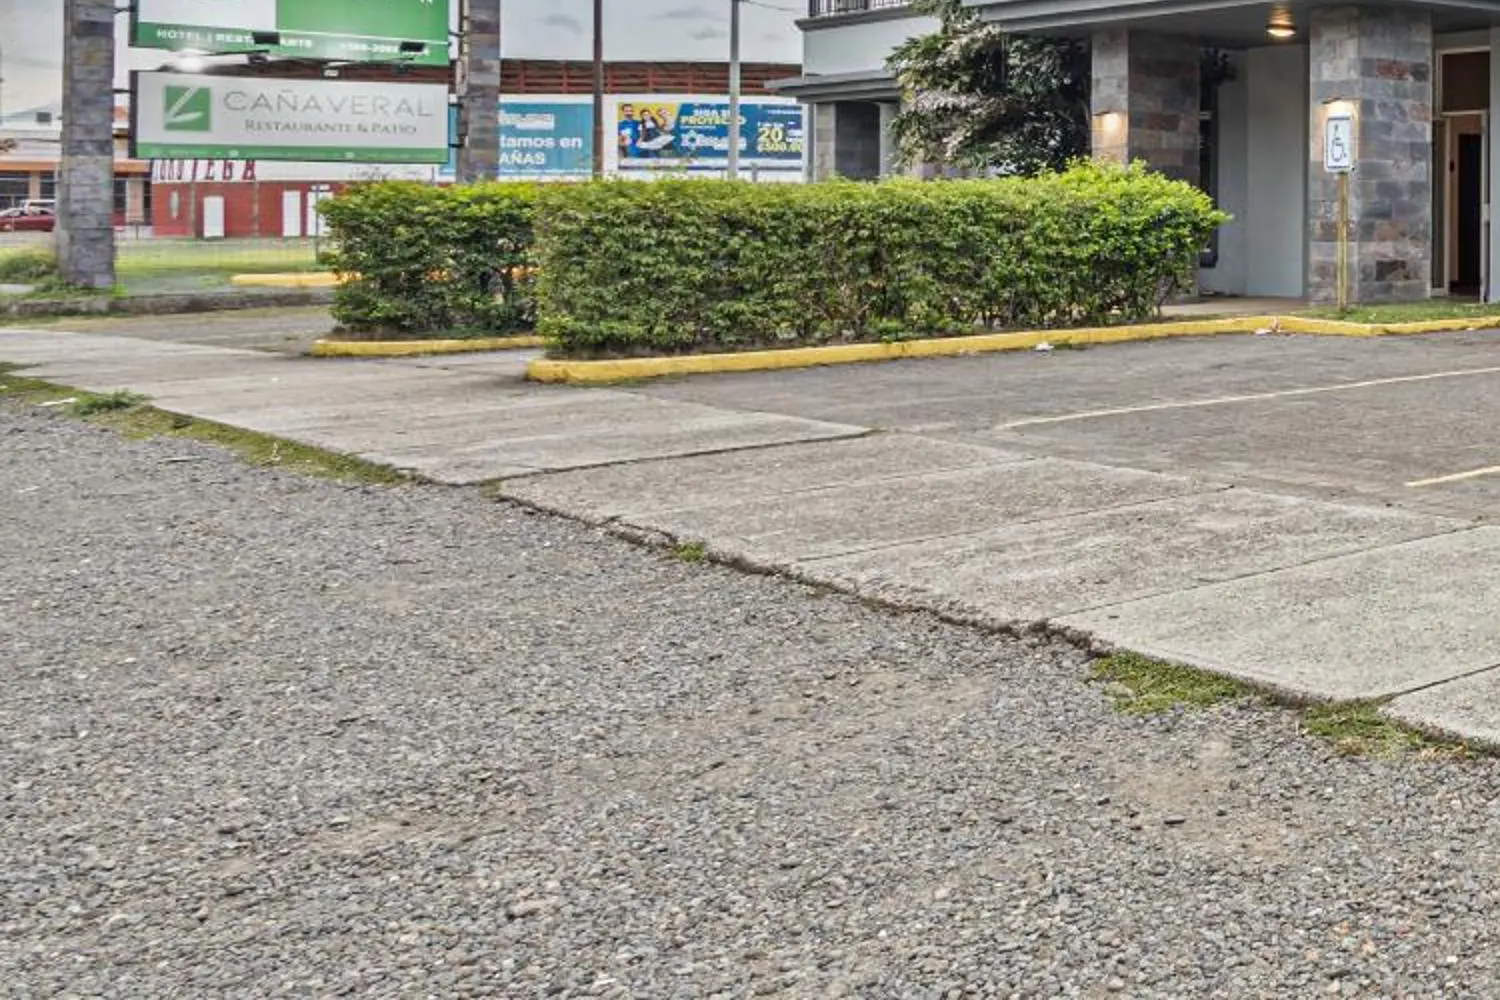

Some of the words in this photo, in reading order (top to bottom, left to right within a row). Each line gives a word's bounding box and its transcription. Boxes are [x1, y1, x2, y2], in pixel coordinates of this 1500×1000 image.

[223, 88, 433, 118] CAÑAVERAL
[245, 119, 351, 134] RESTAURANTE
[371, 122, 417, 135] PATIO
[500, 133, 556, 149] tamos
[560, 136, 583, 150] en
[499, 149, 546, 165] AÑAS
